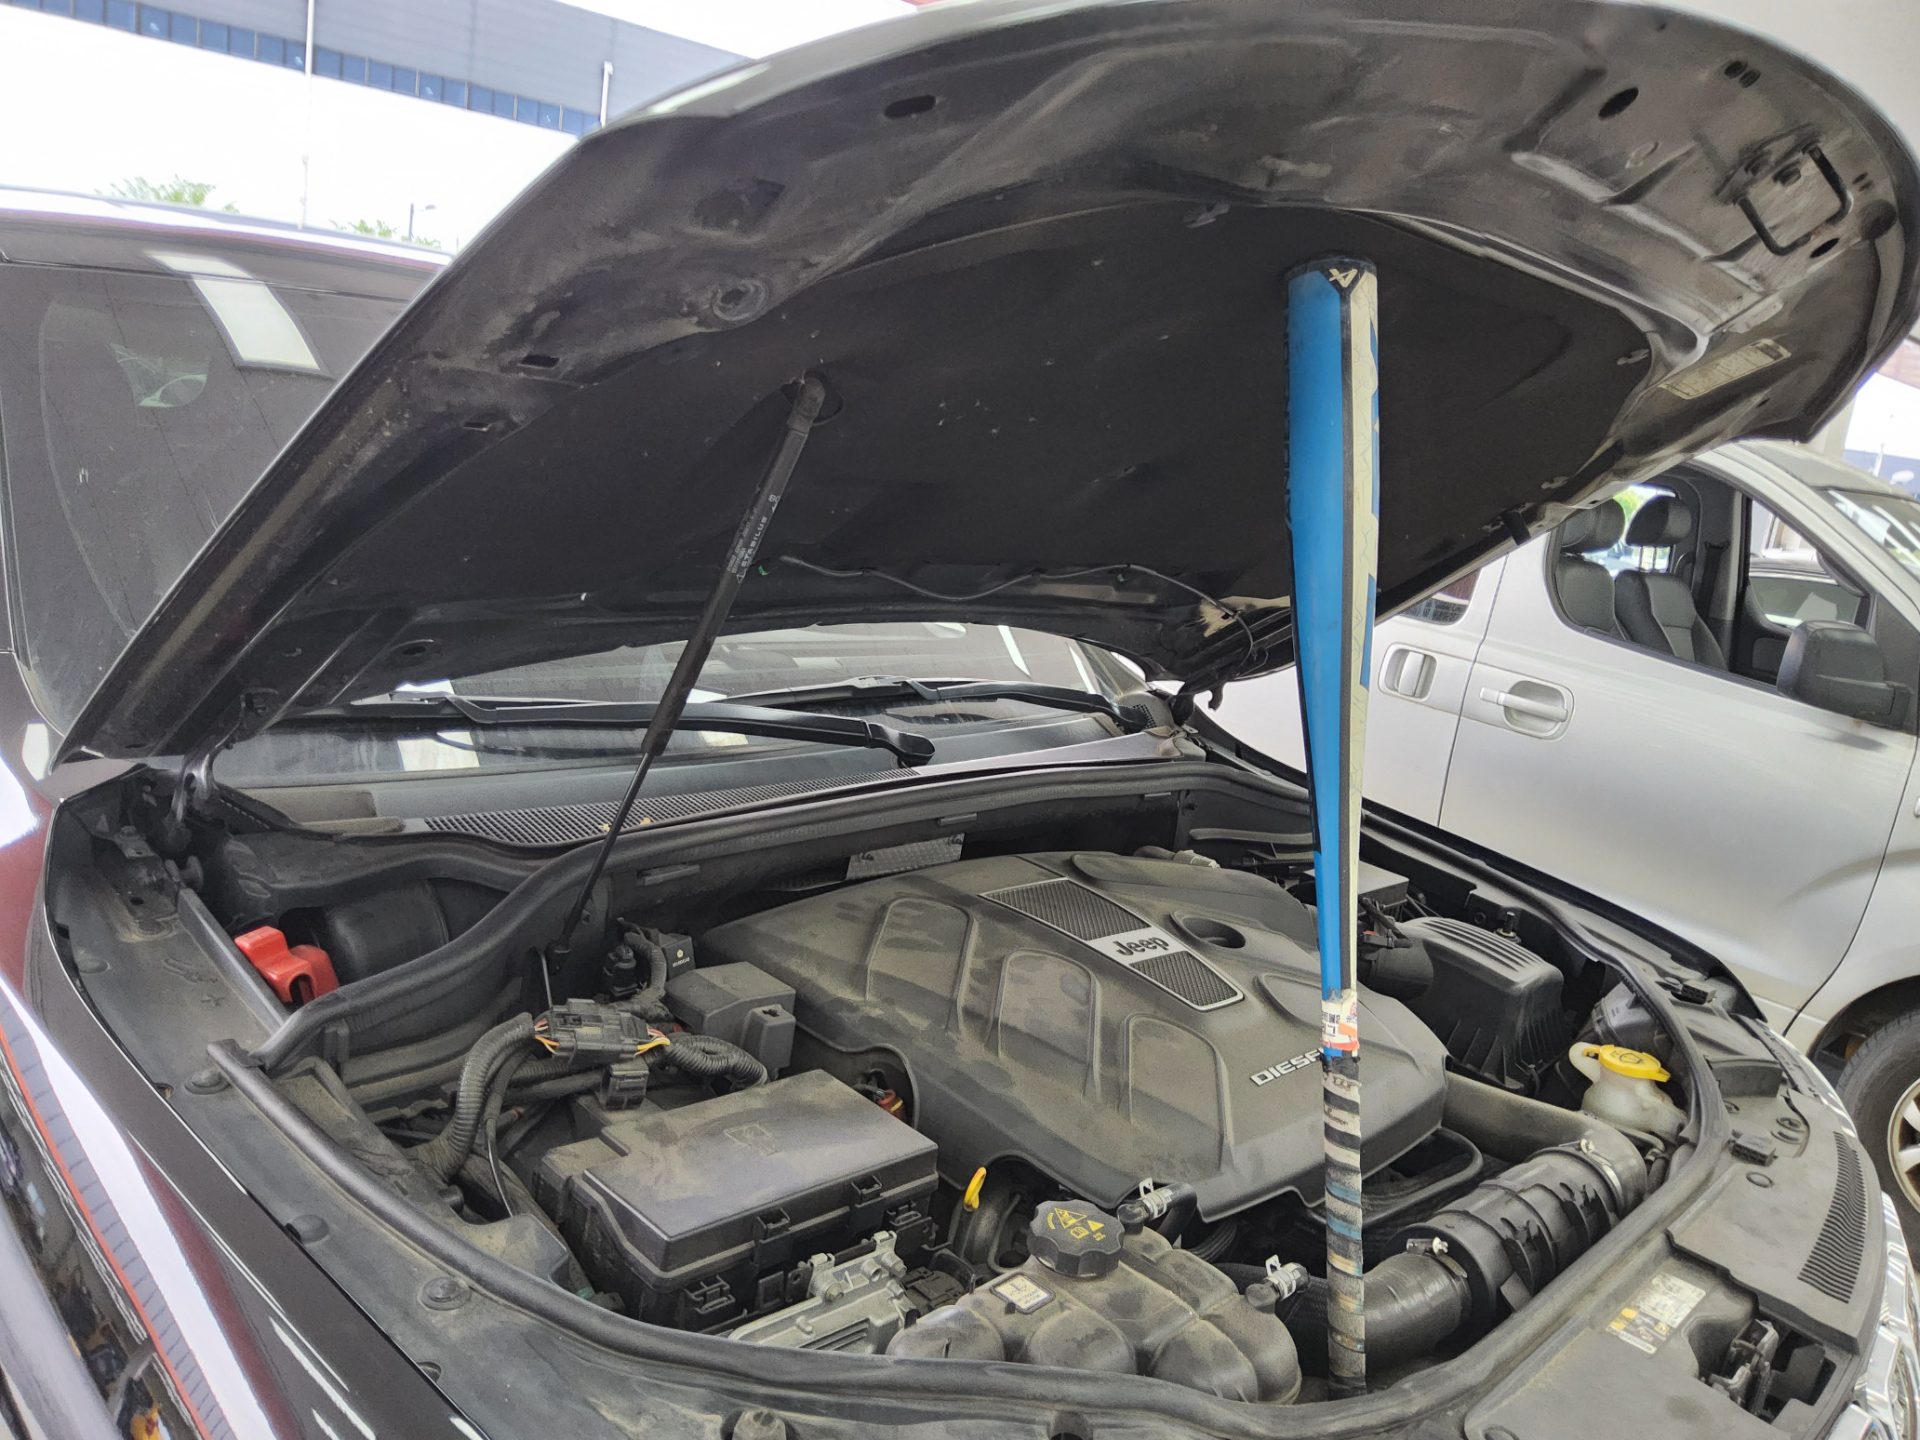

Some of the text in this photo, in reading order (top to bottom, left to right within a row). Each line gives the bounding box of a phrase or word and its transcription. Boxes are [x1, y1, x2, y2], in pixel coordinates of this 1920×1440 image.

[741, 516, 768, 568] STABILUS
[1113, 937, 1169, 956] Jeep
[1250, 1047, 1324, 1086] DIESE
